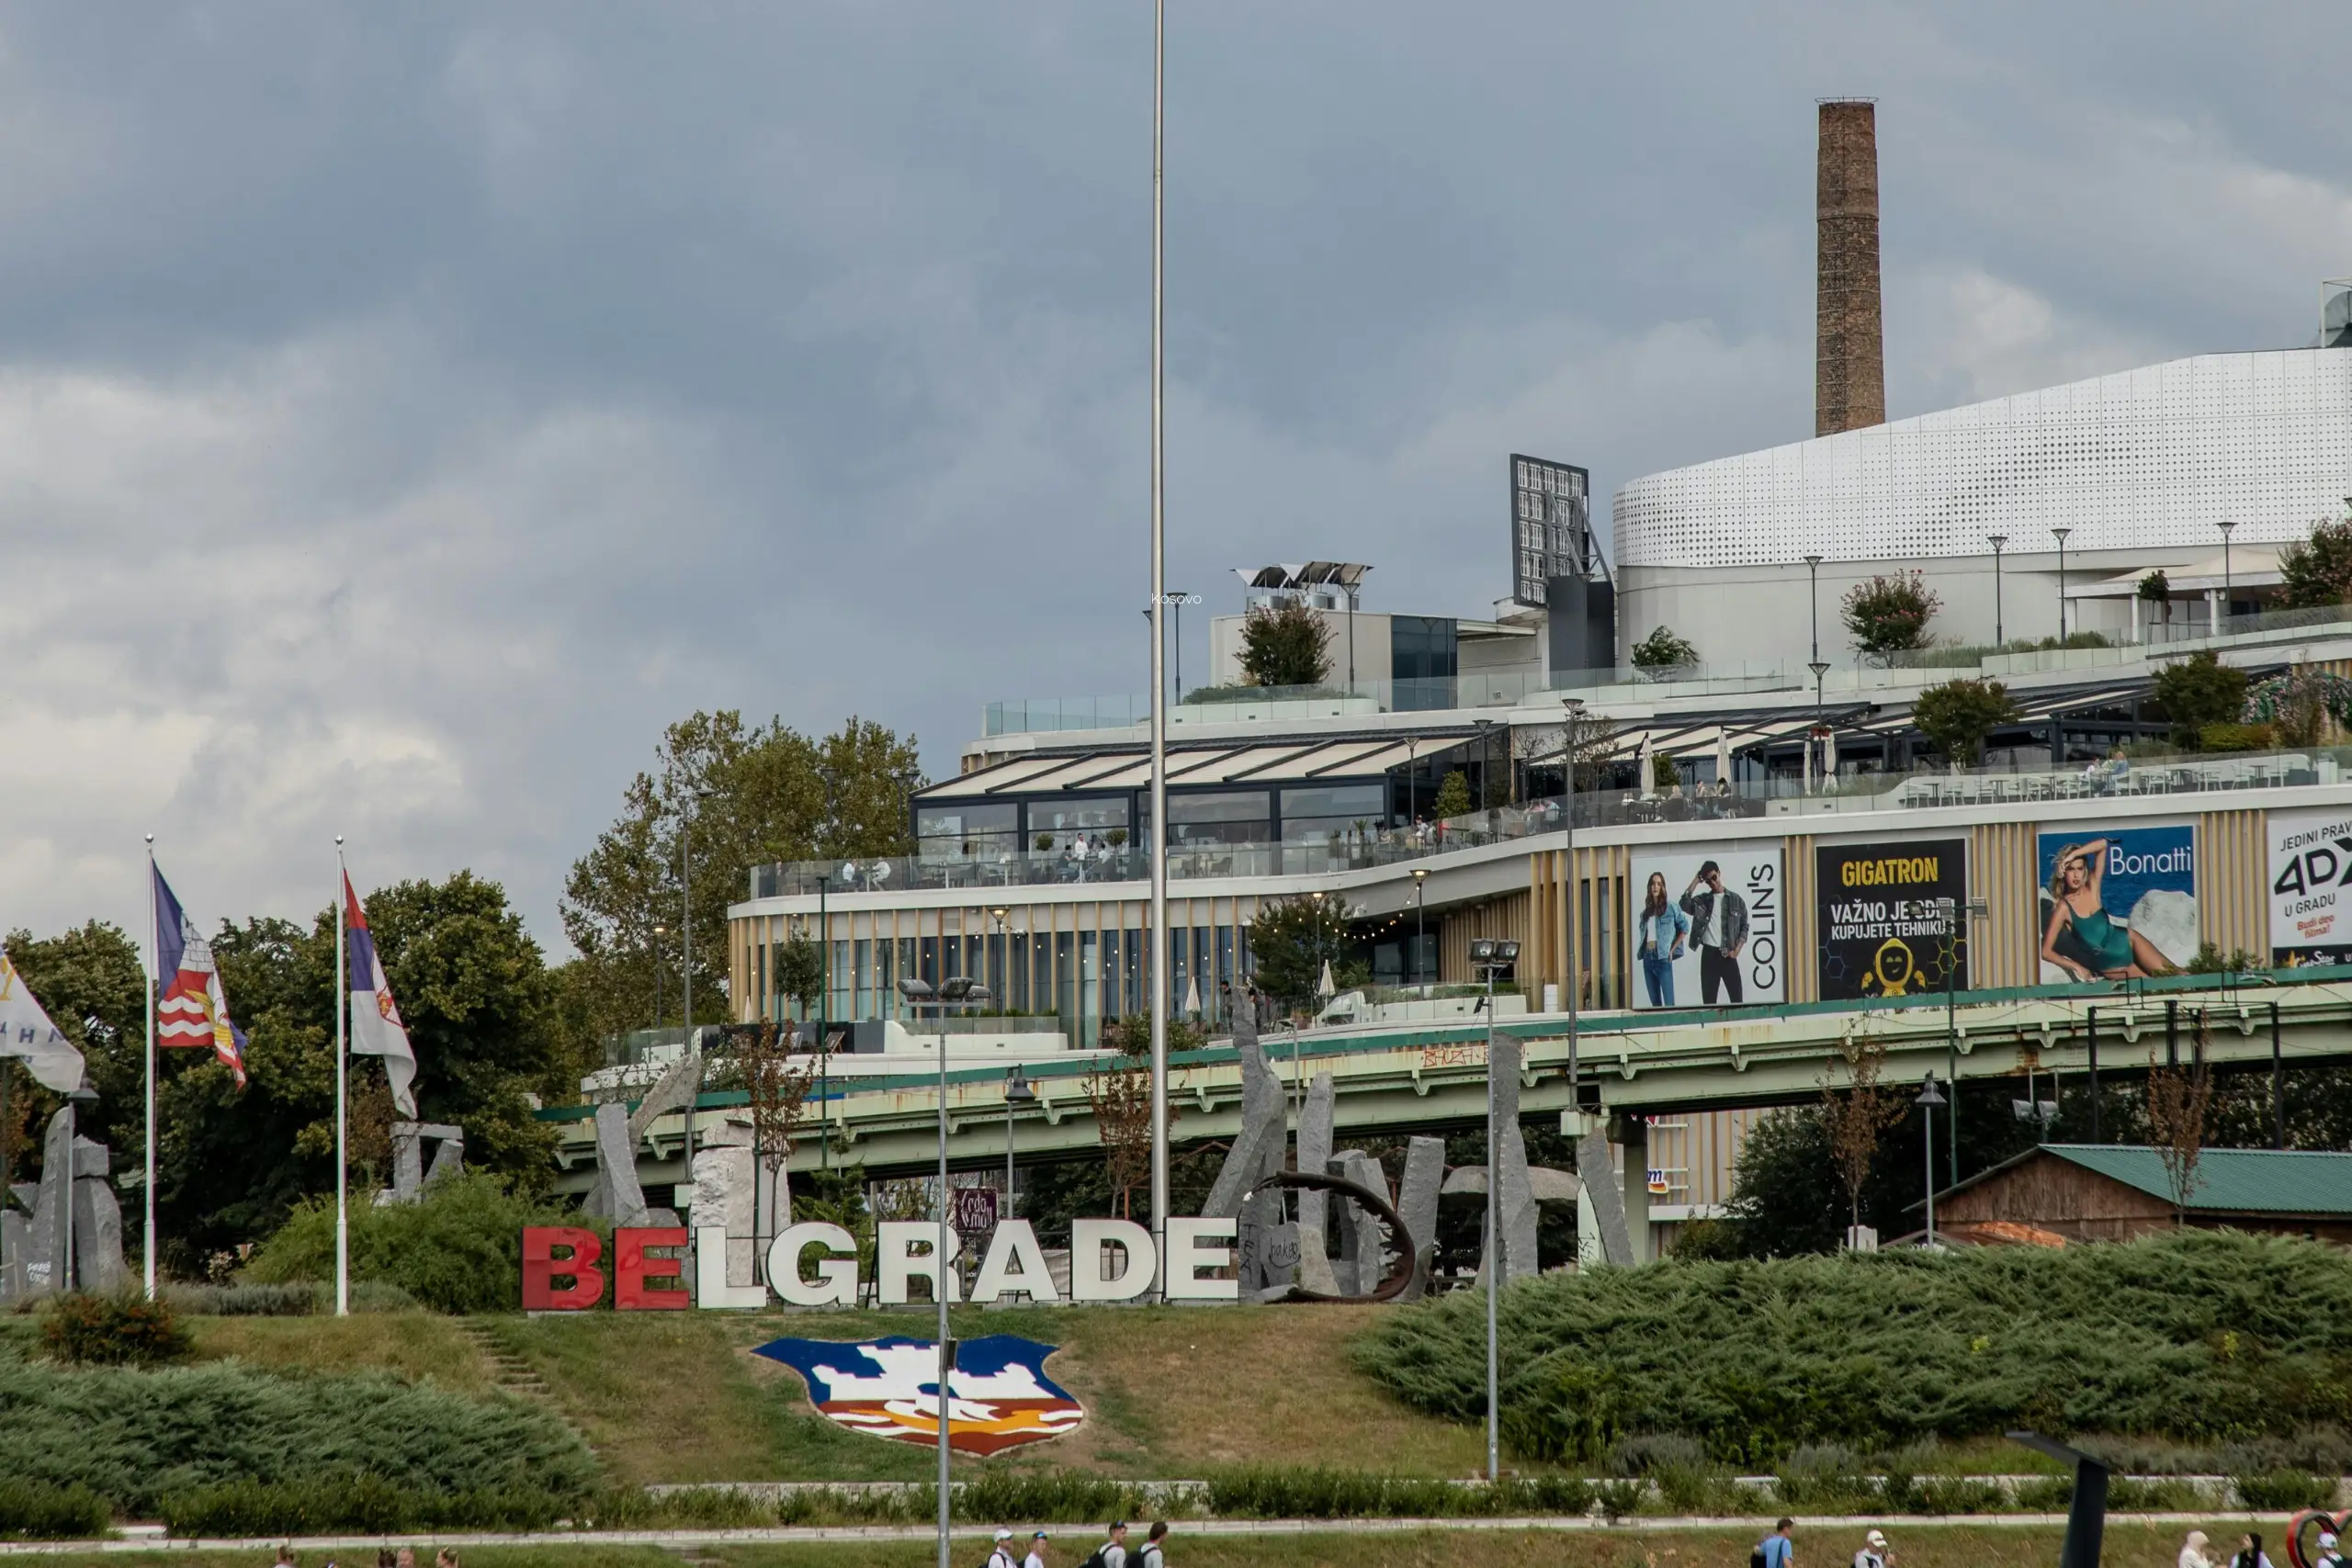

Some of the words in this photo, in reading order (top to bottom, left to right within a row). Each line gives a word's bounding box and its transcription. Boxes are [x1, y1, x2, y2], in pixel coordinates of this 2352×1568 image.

[2280, 829, 2318, 852] JEDINI
[1841, 857, 1939, 886] GIGATRON
[2109, 845, 2192, 876] Bonatti
[1831, 898, 1886, 923] VAŽNO
[1891, 900, 1909, 920] JE
[2284, 904, 2293, 917] U
[2295, 893, 2336, 914] GRADU
[1746, 863, 1777, 990] COLIN'S
[1831, 924, 1893, 941] KUPUJETE
[522, 1217, 1238, 1311] BELGRADE
